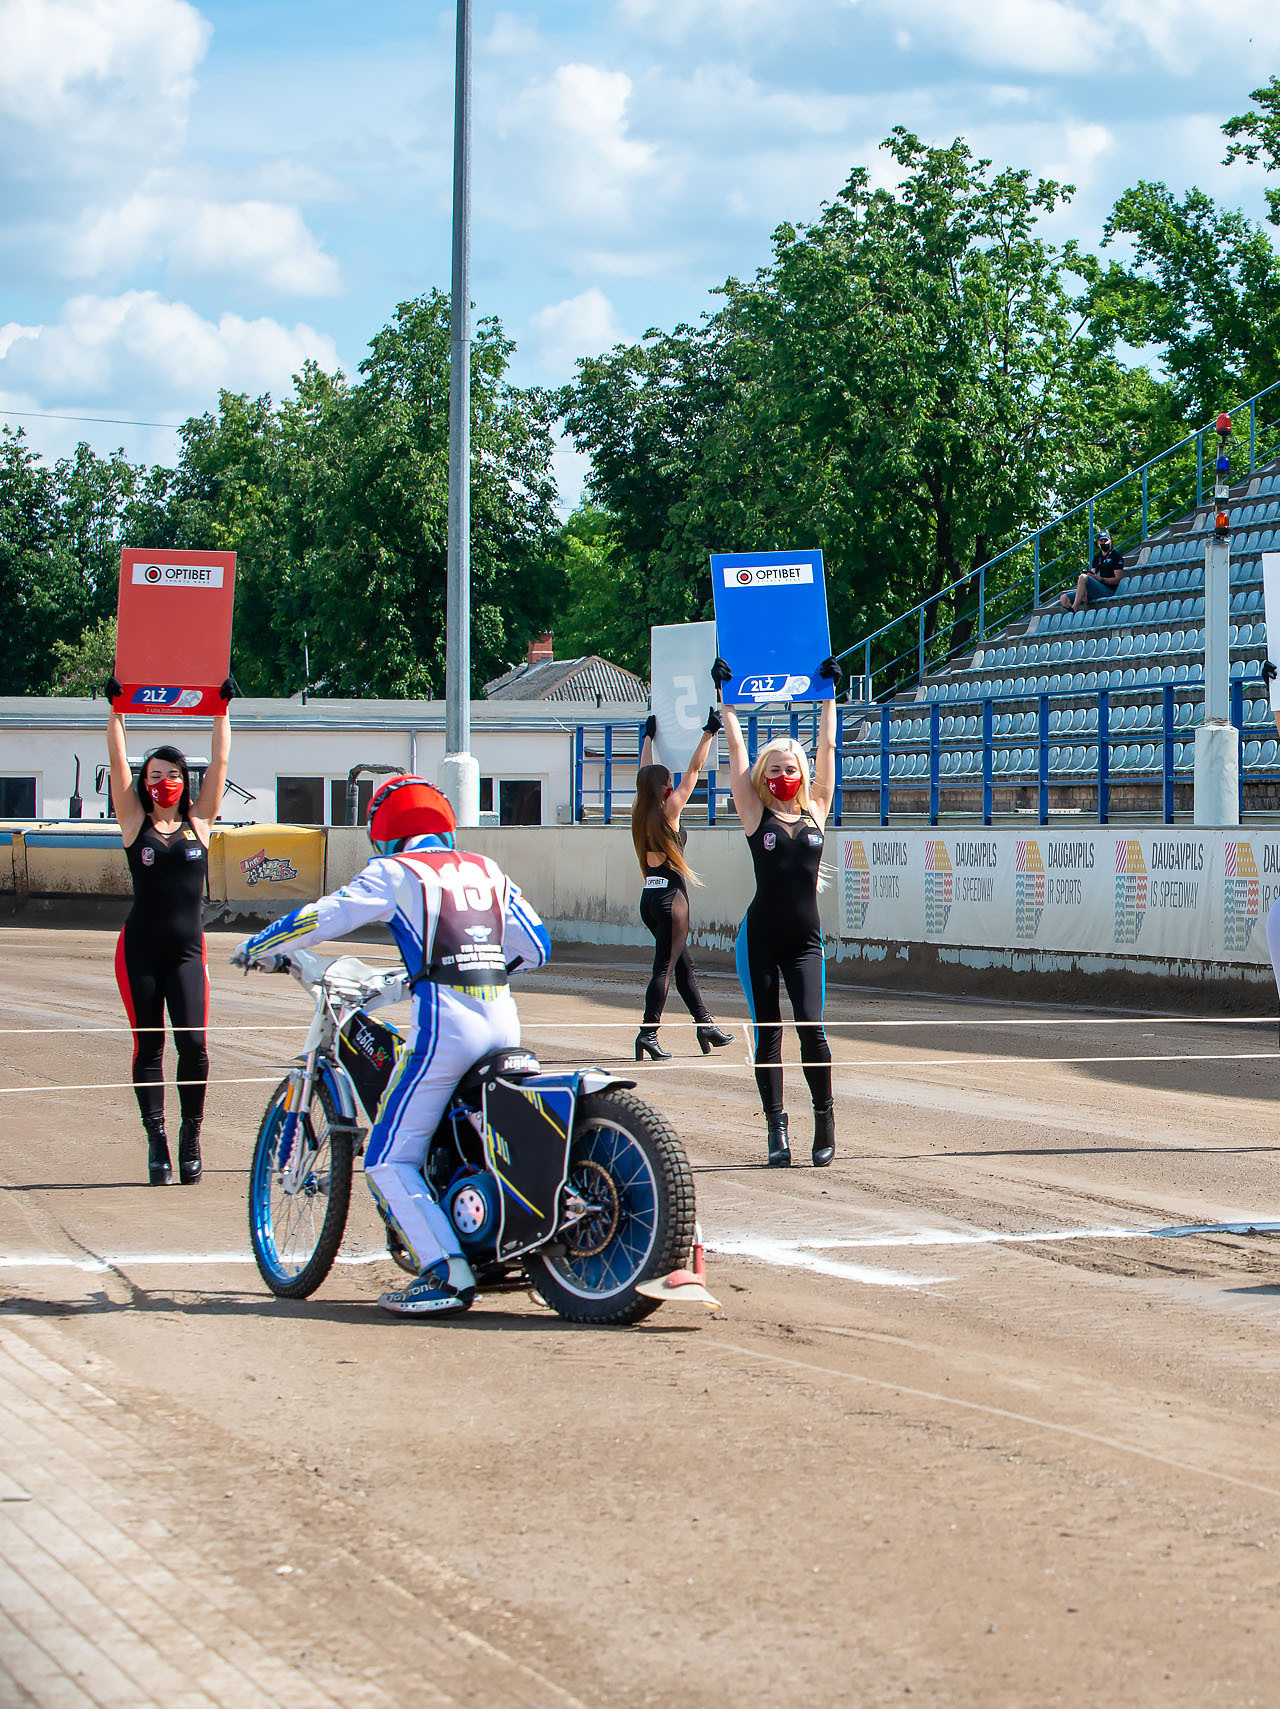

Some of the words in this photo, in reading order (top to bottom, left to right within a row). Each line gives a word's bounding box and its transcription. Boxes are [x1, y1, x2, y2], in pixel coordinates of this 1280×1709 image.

[165, 568, 212, 580] OPTIBET
[755, 567, 801, 580] OPTIBET
[142, 687, 168, 703] 2LŻ
[750, 677, 775, 692] 2LŻ
[872, 842, 908, 866] DAUGAVPILS
[955, 842, 997, 868] DAUGAVPILS
[1047, 842, 1095, 870] DAUGAVPILS
[1151, 842, 1204, 871] DAUGAVPILS
[880, 875, 900, 899] SPORTS
[963, 877, 994, 902] SPEEDWAY
[1047, 879, 1055, 905] IR
[1056, 879, 1082, 905] SPORTS
[1150, 882, 1158, 909] IS
[1160, 882, 1199, 910] SPEEDWAY
[1262, 885, 1271, 912] IR
